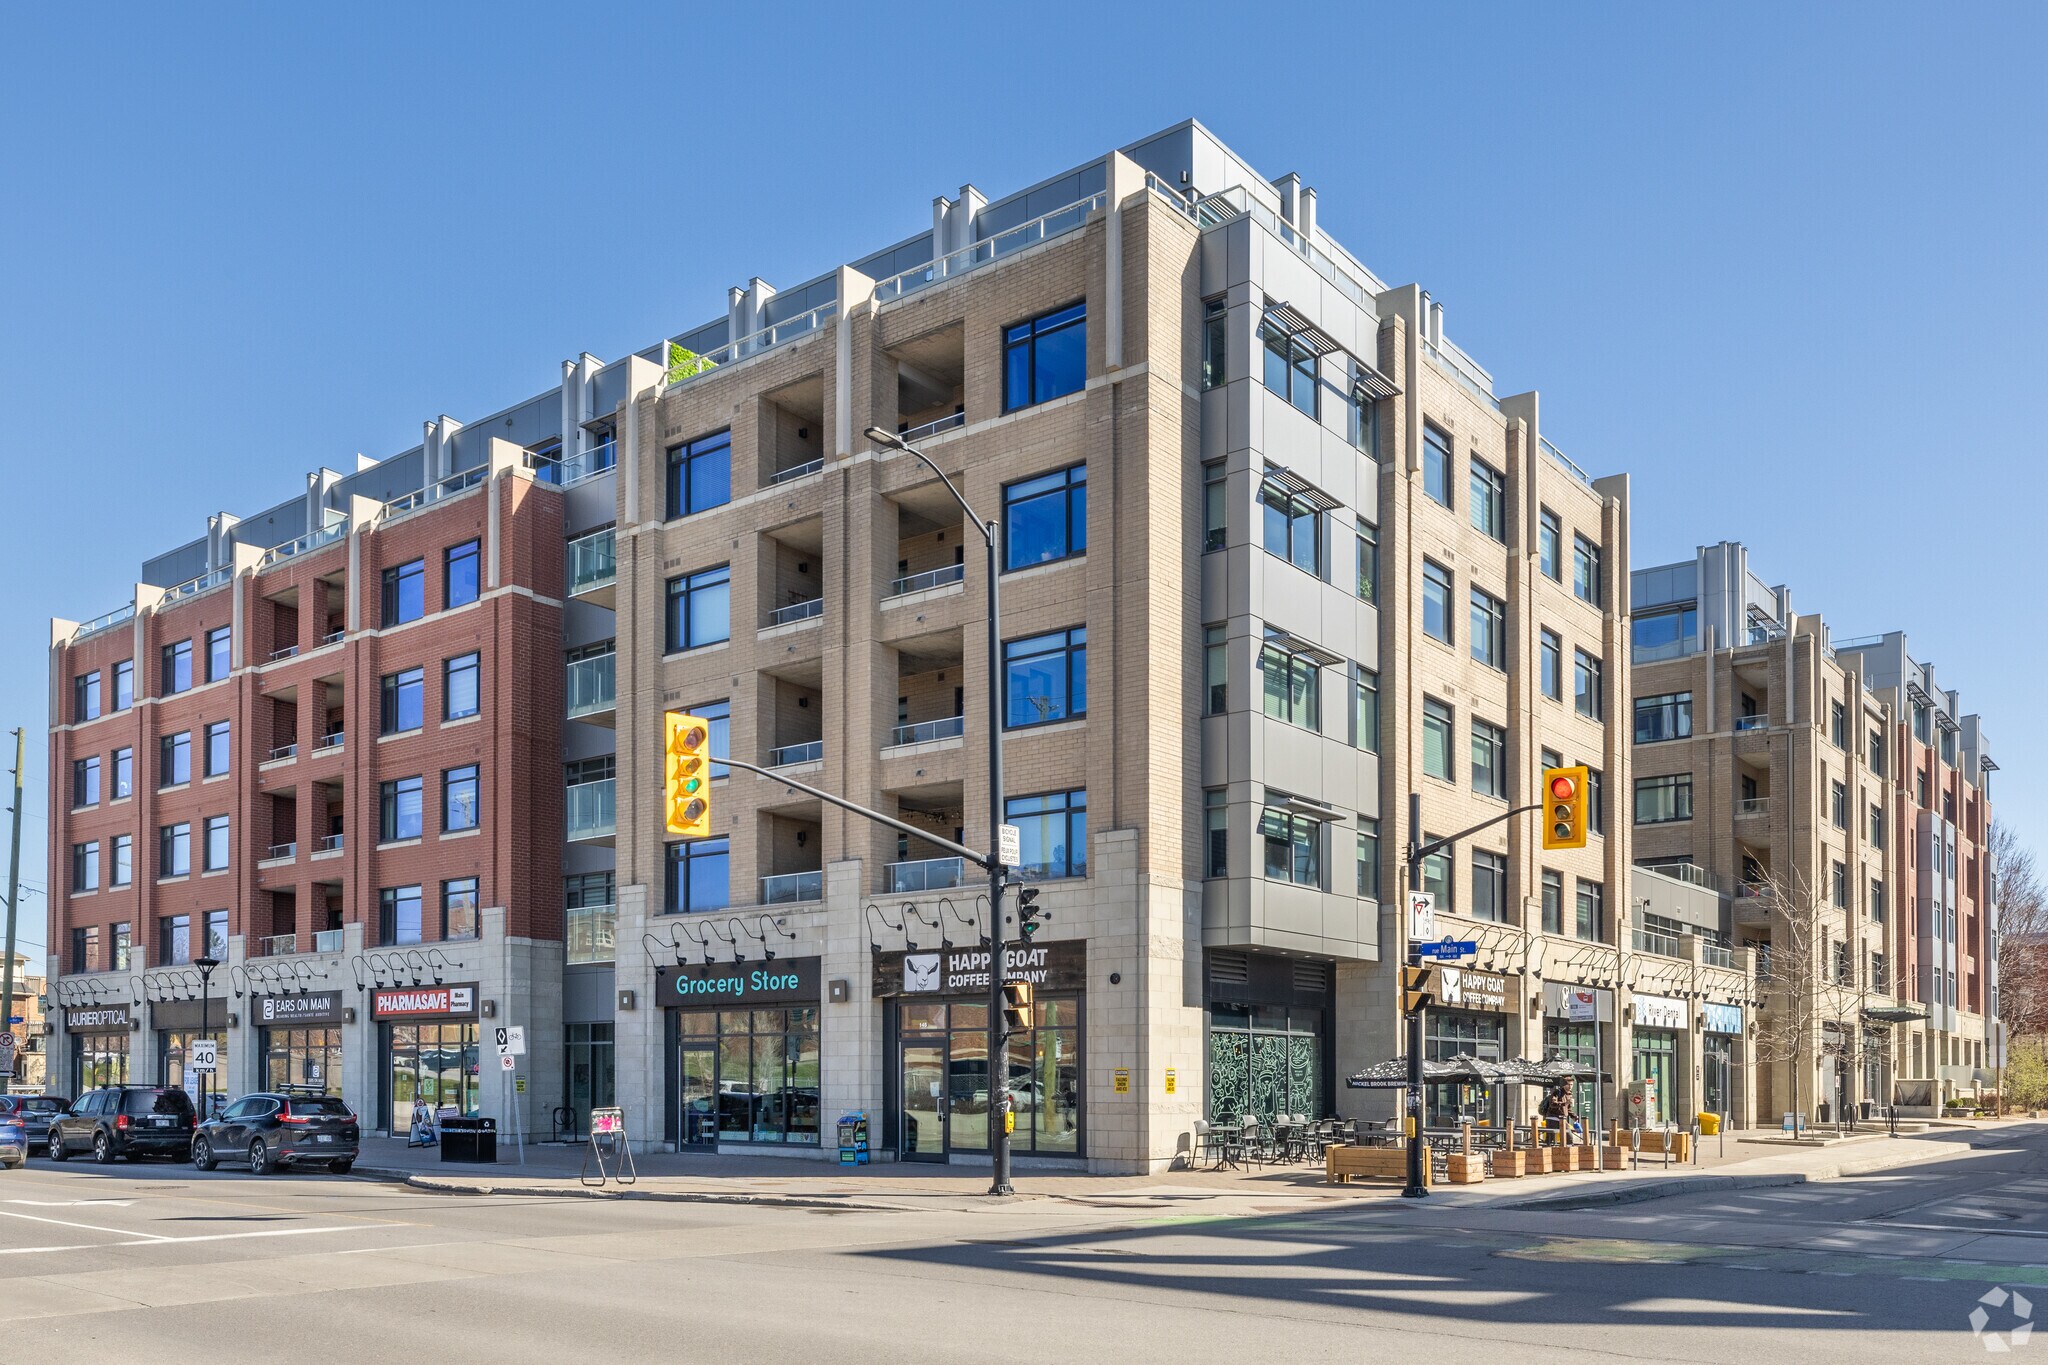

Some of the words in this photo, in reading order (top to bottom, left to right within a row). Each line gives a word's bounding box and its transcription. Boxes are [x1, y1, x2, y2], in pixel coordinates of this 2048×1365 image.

[1440, 944, 1458, 954] Main
[948, 952, 991, 972] HAPP
[1006, 948, 1049, 968] GOAT
[676, 975, 744, 997] Grocery
[750, 970, 799, 991] Store
[948, 972, 990, 988] COFFEE
[1006, 970, 1047, 984] MPANY
[1462, 973, 1487, 991] HAPPY
[1486, 976, 1505, 993] GOAT
[378, 993, 447, 1011] PHARMASAVE
[454, 991, 465, 999] Main
[1462, 991, 1482, 1004] COFFEE
[1481, 993, 1506, 1007] COMPANY
[276, 999, 295, 1012] EARS
[296, 998, 309, 1011] ON
[310, 997, 331, 1010] MAIN
[450, 1000, 470, 1009] Pharmacy
[1648, 1003, 1662, 1017] River
[1663, 1005, 1680, 1020] Dental
[195, 1052, 214, 1064] 40
